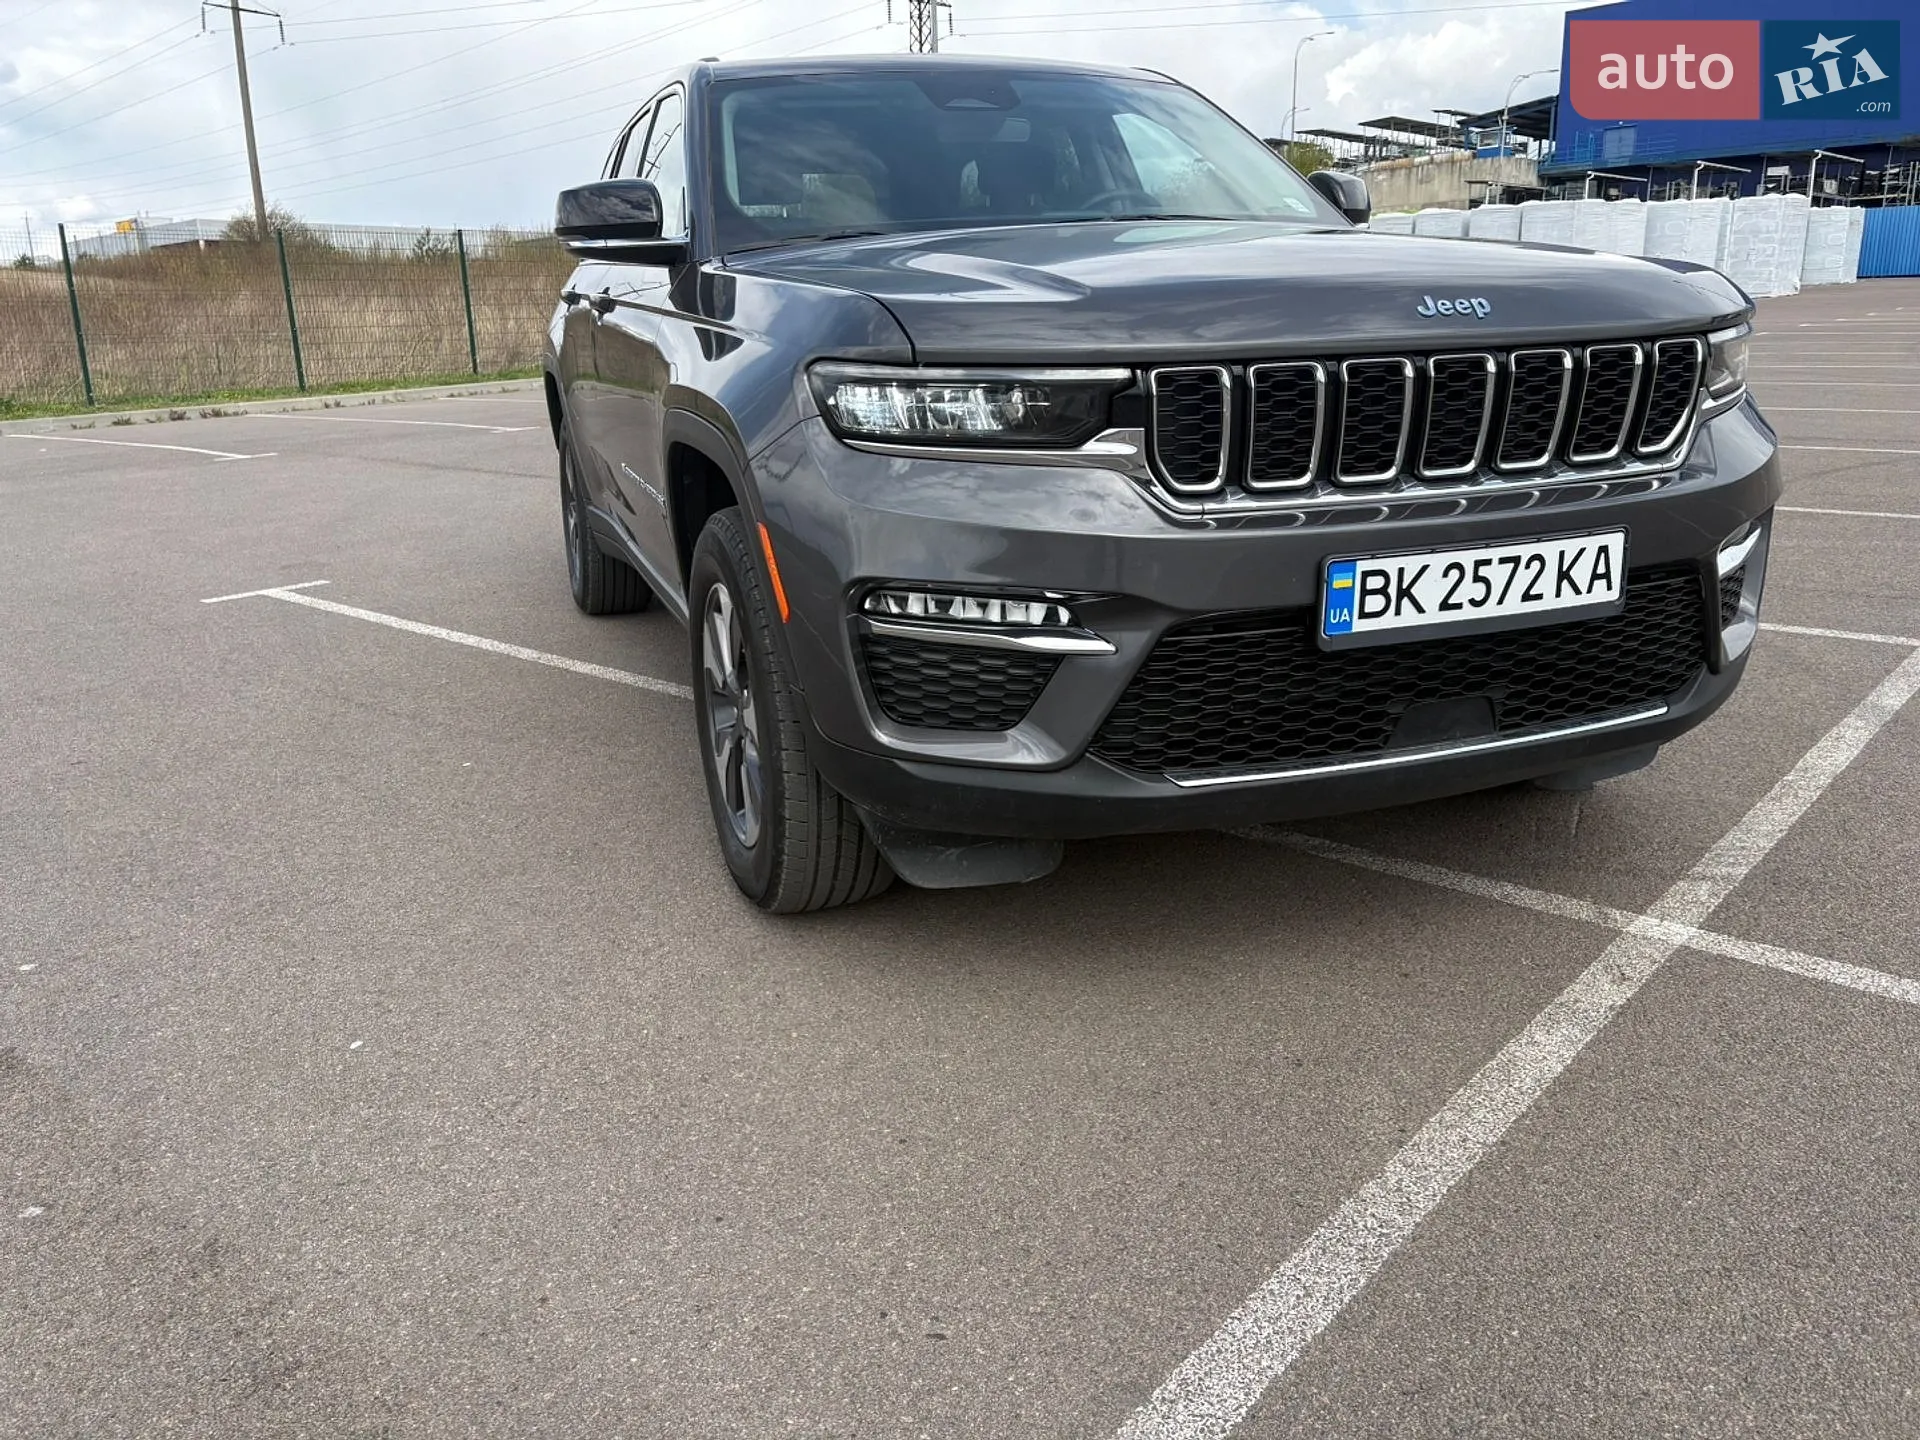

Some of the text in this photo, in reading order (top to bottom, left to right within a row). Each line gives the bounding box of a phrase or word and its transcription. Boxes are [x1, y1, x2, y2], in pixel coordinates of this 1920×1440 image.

[1417, 295, 1491, 319] Jeep
[1357, 544, 1613, 620] BK 2572 KA
[1330, 607, 1350, 624] UA
